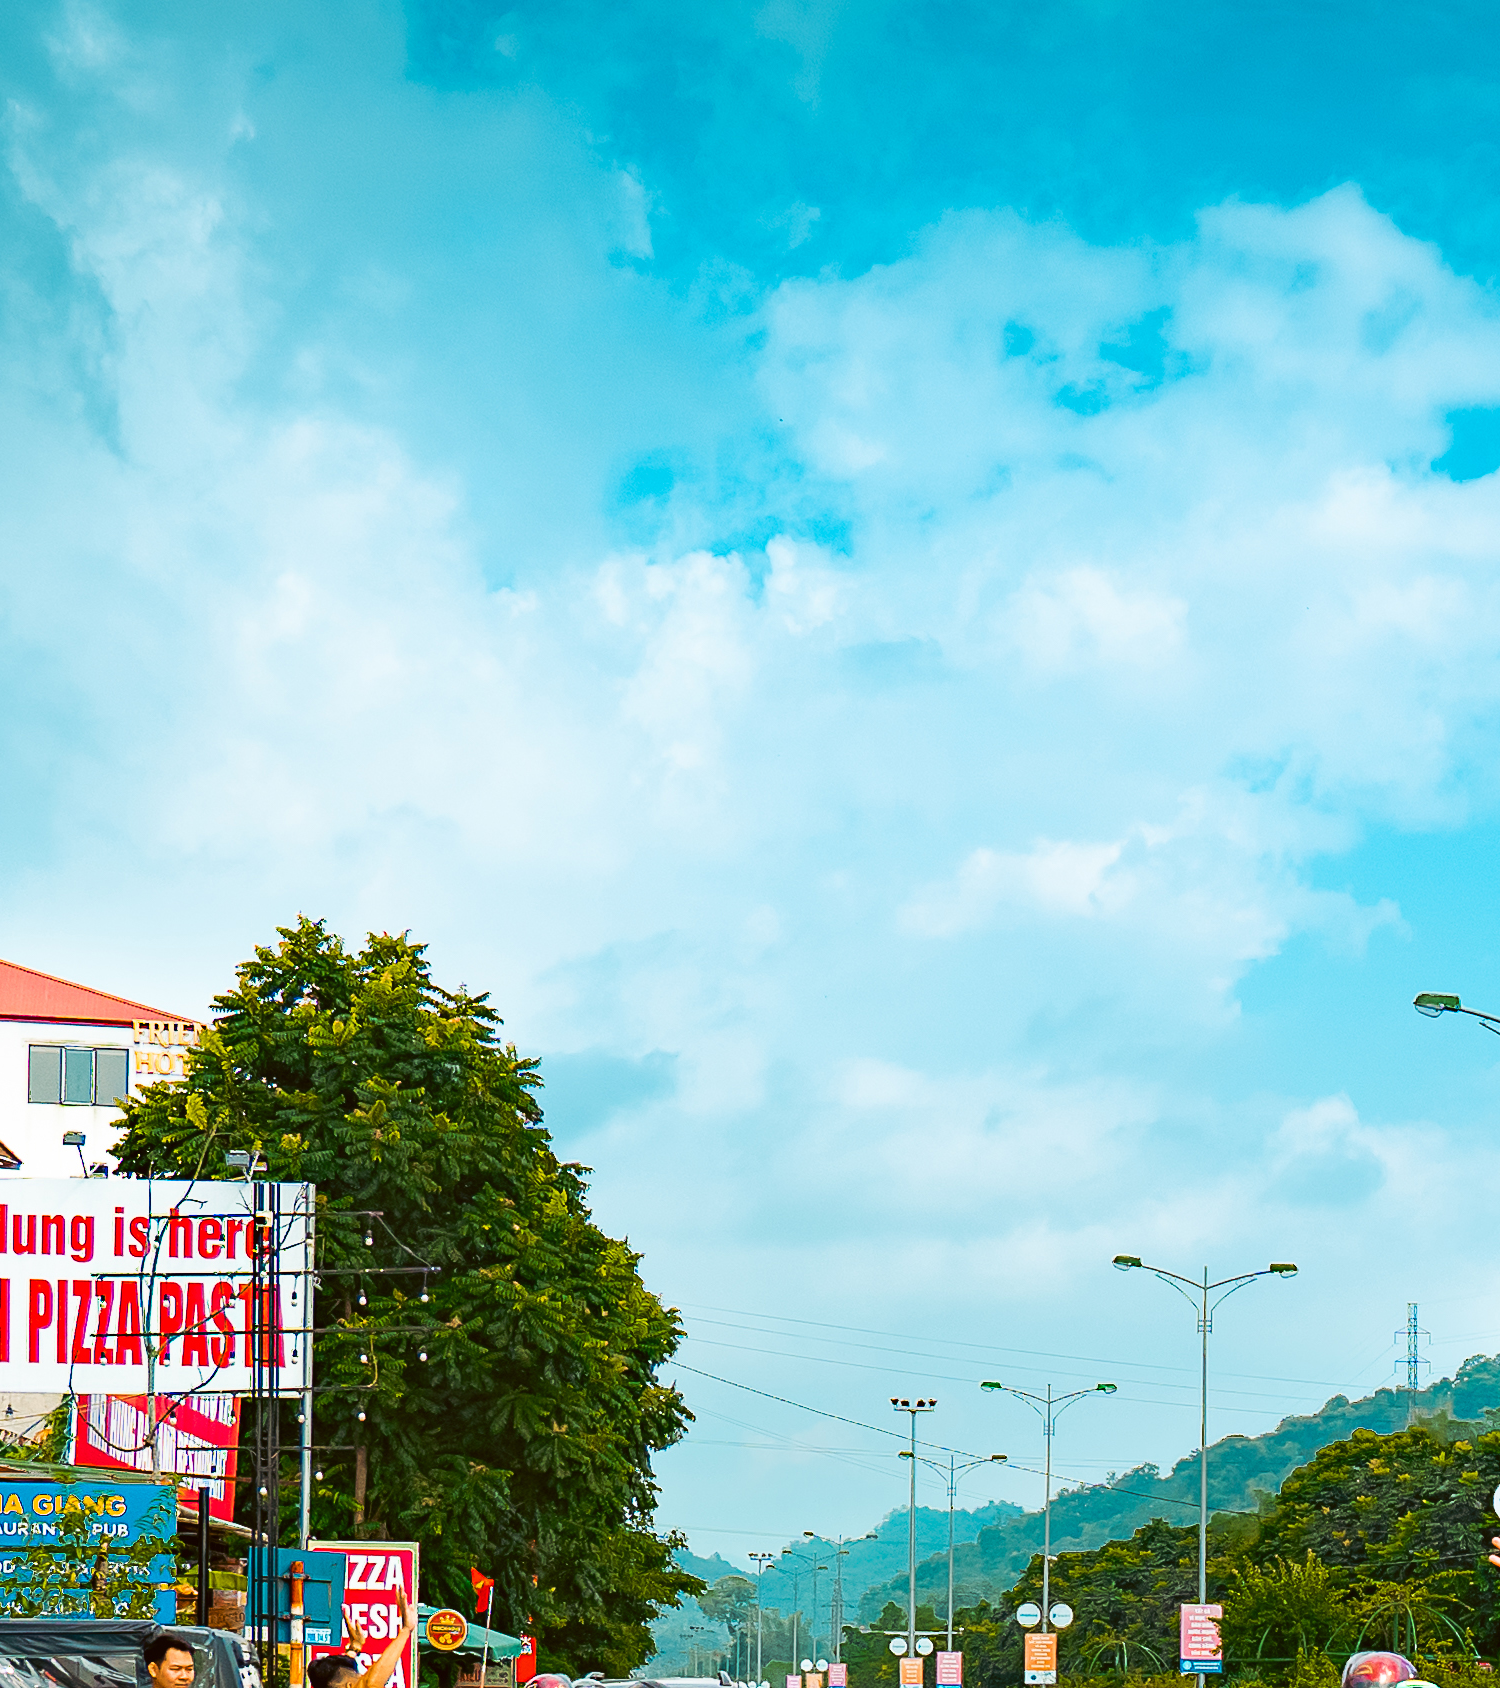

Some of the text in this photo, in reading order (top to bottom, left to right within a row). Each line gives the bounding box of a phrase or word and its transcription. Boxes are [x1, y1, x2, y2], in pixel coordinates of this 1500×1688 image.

[113, 1207, 151, 1258] is
[169, 1207, 271, 1260] here
[28, 1279, 144, 1366] PIZZA
[159, 1281, 287, 1369] PASTA
[32, 1494, 127, 1517] GIANG
[93, 1522, 129, 1537] PUB
